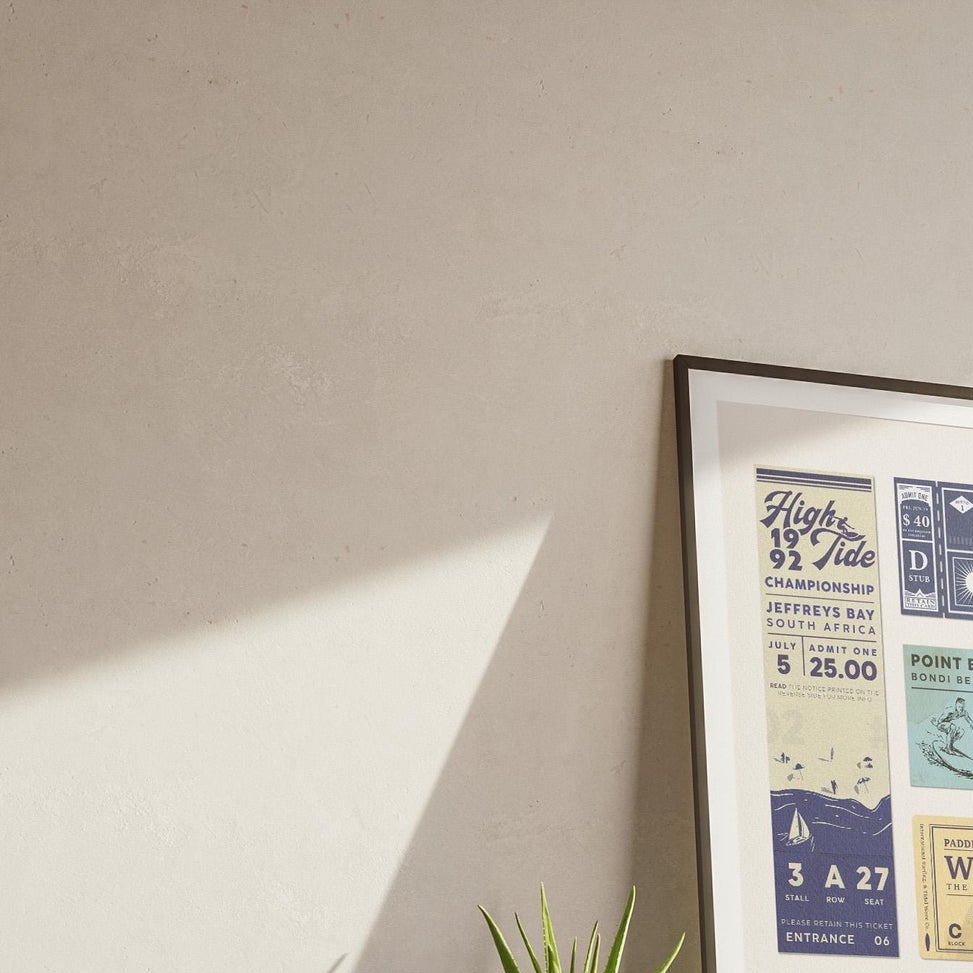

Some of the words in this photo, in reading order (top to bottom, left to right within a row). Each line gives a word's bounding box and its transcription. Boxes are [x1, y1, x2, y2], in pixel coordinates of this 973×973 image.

[760, 490, 836, 536] High
[903, 513, 910, 526] $
[914, 515, 930, 527] 40
[771, 528, 799, 549] 19
[810, 528, 876, 570] Tide
[769, 549, 803, 571] 92
[909, 550, 928, 570] D
[765, 576, 874, 595] CHAMPIONSHIP
[766, 602, 841, 618] JEFFREYS
[846, 608, 875, 620] BAY
[767, 618, 816, 630] SOUTH
[824, 623, 876, 635] AFRICA
[768, 641, 796, 650] JULY
[809, 644, 847, 654] ADMIT
[853, 647, 877, 656] ONE
[777, 654, 790, 674] 5
[809, 657, 877, 681] 25.00
[911, 654, 961, 669] POINT
[912, 673, 950, 683] BONDI
[788, 863, 804, 887] 3
[824, 865, 845, 889] A
[856, 866, 889, 891] 27
[947, 883, 968, 891] THE
[781, 918, 811, 926] PLEASE
[865, 922, 893, 930] TICKET
[948, 923, 962, 939] C
[786, 932, 855, 945] ENTRANCE
[874, 935, 890, 946] 06
